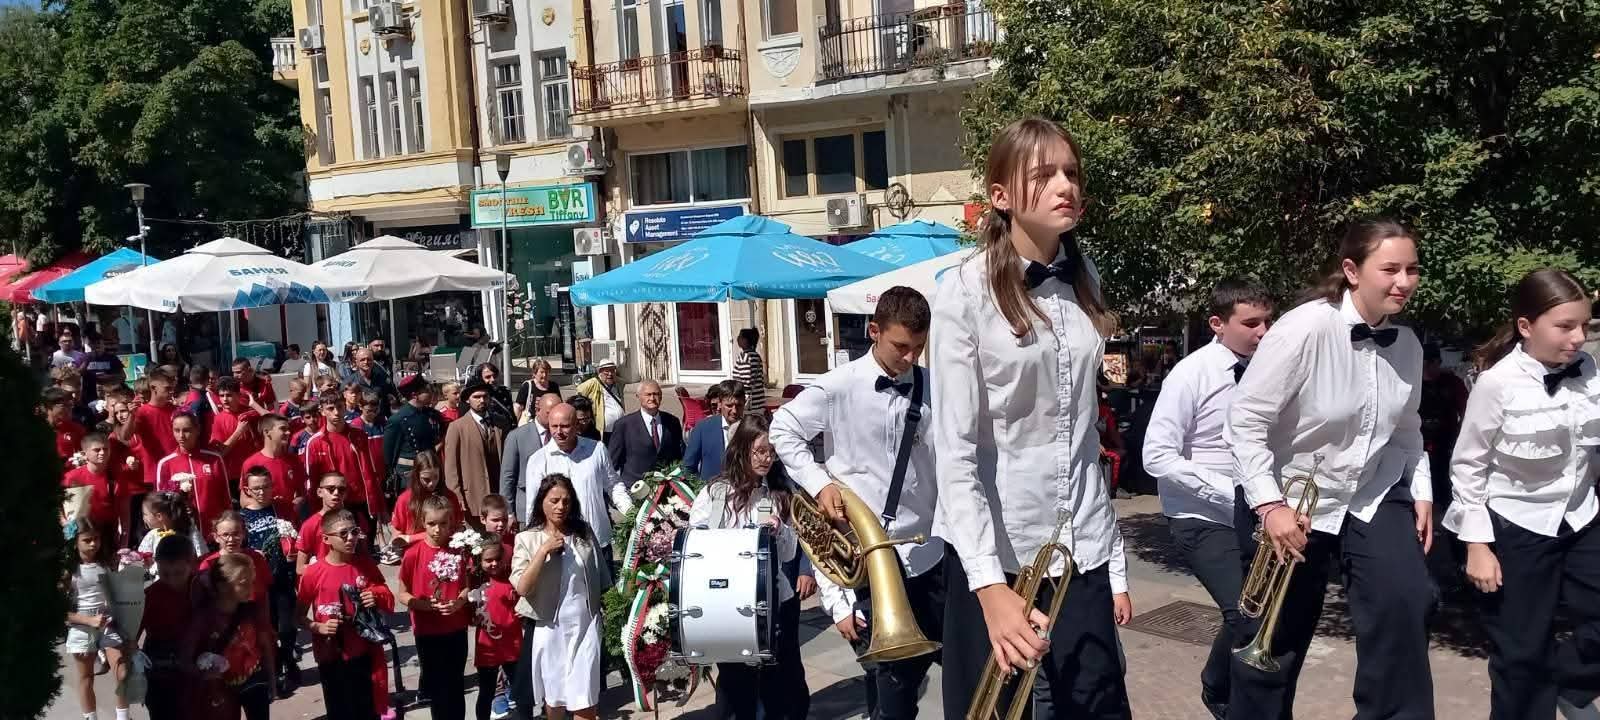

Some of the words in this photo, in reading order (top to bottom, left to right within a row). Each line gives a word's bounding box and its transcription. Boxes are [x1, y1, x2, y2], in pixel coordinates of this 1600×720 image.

[549, 209, 584, 221] Tiffany
[644, 230, 679, 238] Management
[228, 267, 289, 277] БАНКЯ
